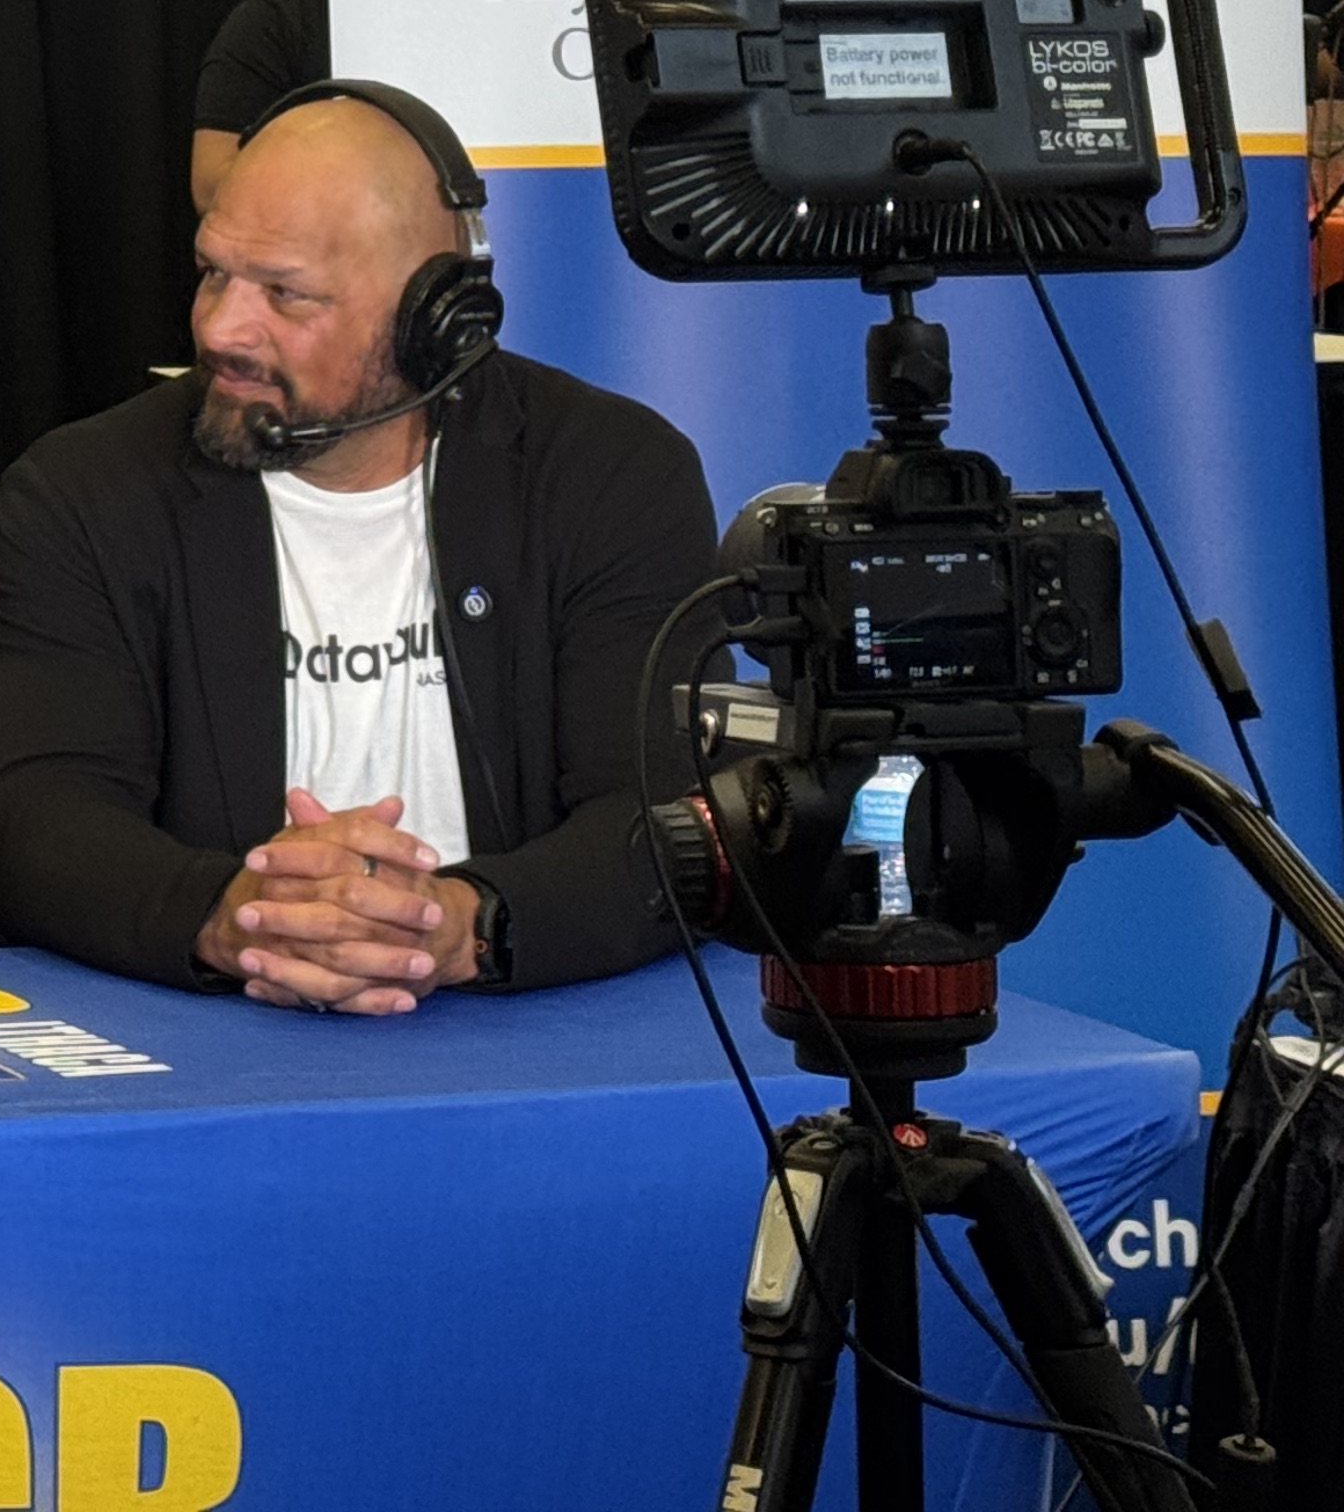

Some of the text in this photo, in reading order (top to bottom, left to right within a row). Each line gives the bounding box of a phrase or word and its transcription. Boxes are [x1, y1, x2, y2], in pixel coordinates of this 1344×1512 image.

[826, 47, 938, 64] Battery power
[1028, 40, 1110, 58] LYKOS
[1031, 57, 1118, 74] bi-color
[830, 70, 857, 87] not
